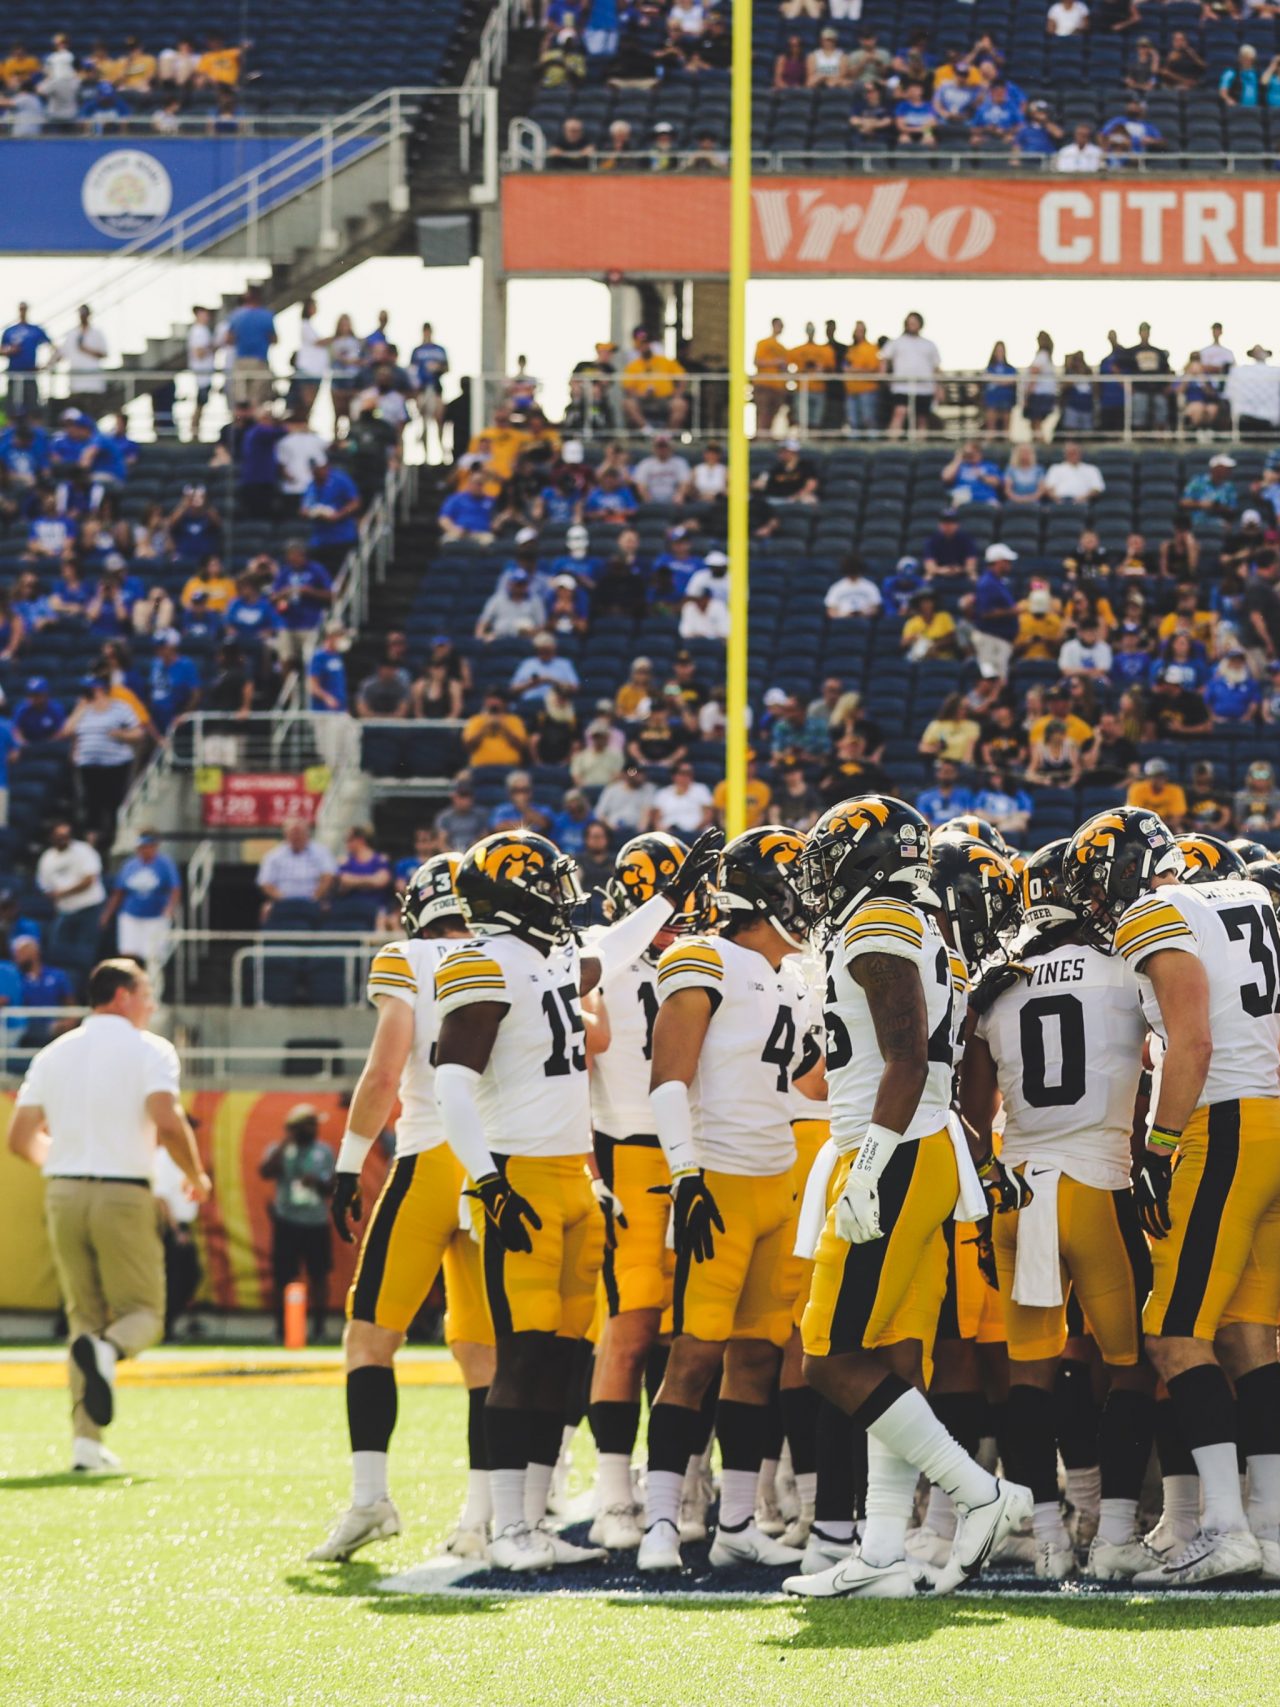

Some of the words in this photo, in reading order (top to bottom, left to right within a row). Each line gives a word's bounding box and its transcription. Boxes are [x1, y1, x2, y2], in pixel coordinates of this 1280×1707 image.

[750, 180, 995, 262] Vrbo
[435, 872, 451, 892] 3
[1026, 957, 1086, 988] VINES
[761, 1004, 796, 1093] 4
[1019, 993, 1086, 1109] 0
